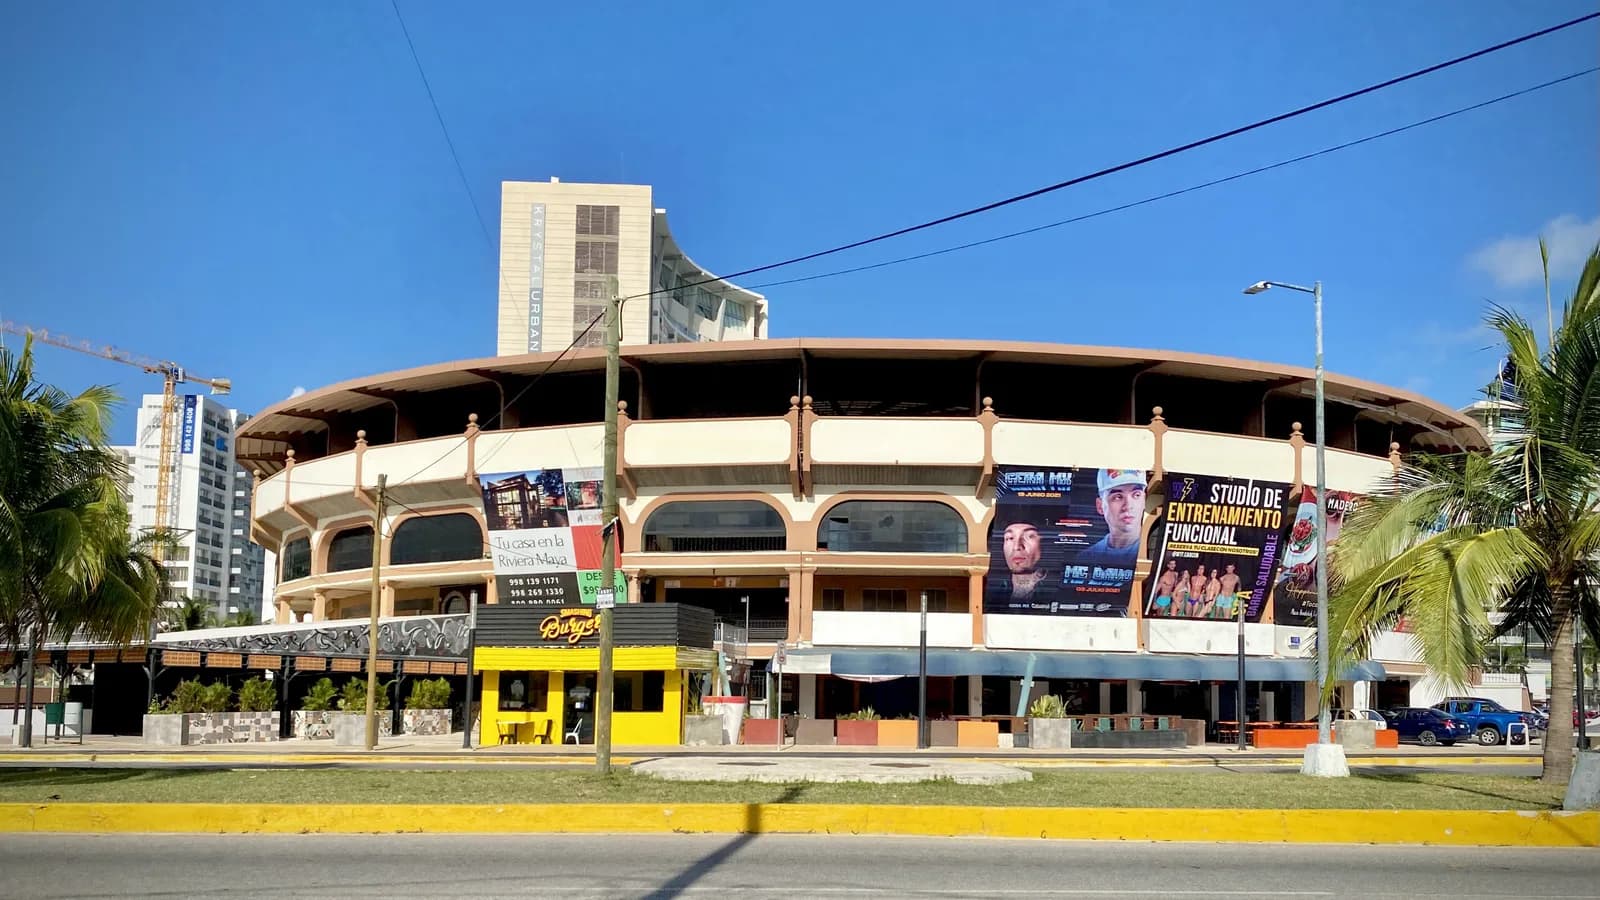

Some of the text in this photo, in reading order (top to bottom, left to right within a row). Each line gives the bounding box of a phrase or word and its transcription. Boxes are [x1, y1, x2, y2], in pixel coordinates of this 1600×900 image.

[529, 206, 543, 351] KRYSTAL URBAN
[1210, 480, 1283, 509] STUDIO DE
[1166, 502, 1282, 530] ENTRENAMIENTO
[495, 534, 564, 549] Tu casa en la
[1165, 522, 1238, 546] FUNCIONAL
[498, 552, 568, 569] Riviera Maya
[509, 576, 559, 586] 998 139 1171
[1064, 565, 1089, 582] MC
[1246, 534, 1279, 617] BARRA SALUDABLE
[510, 587, 564, 597] 998 269 1330
